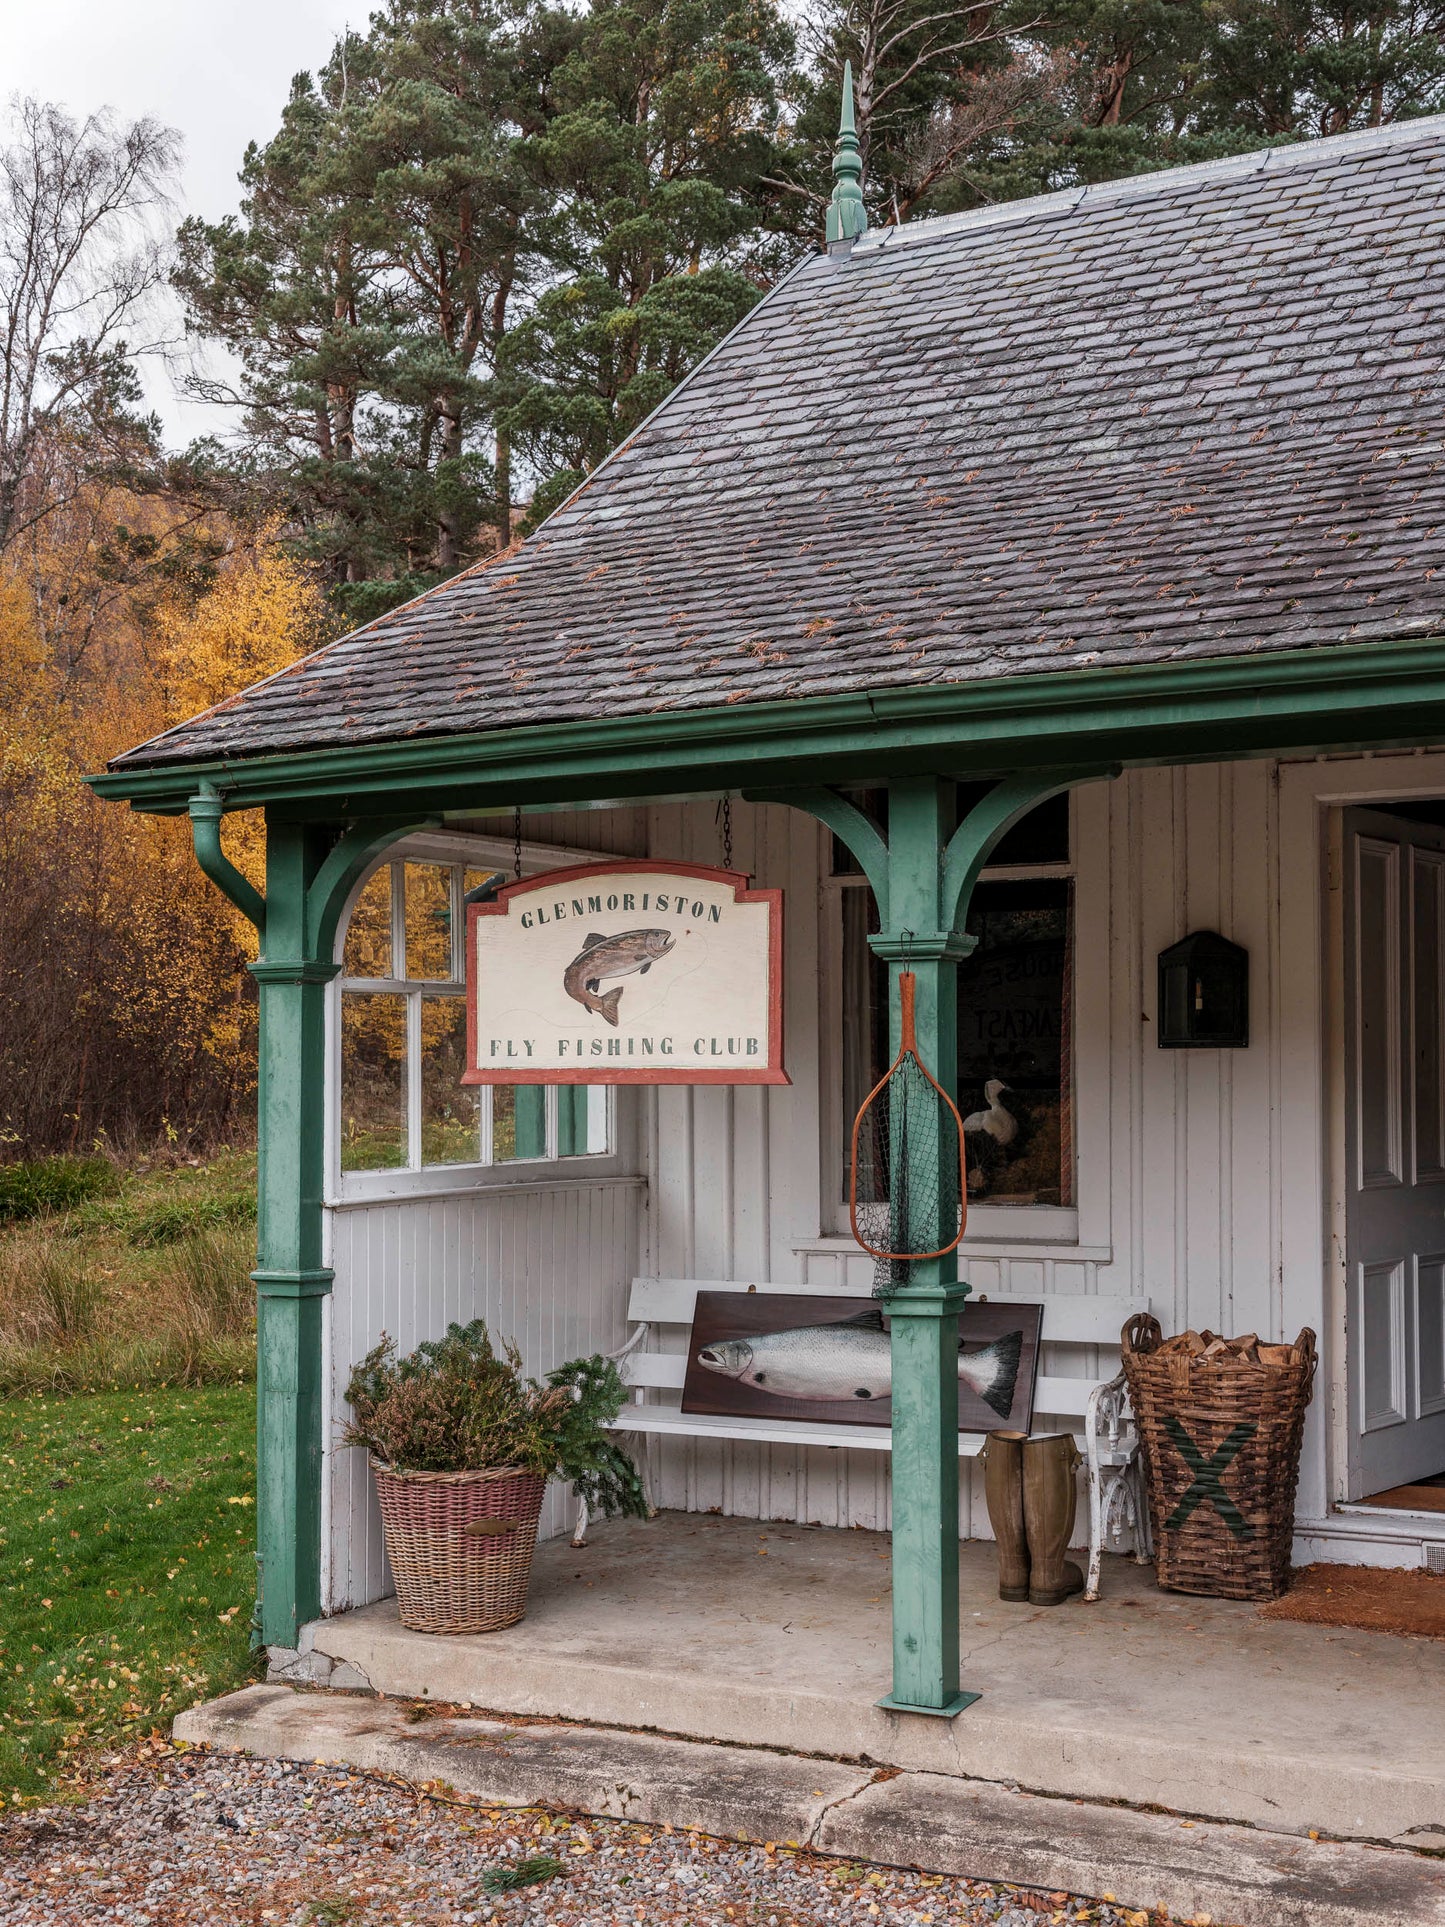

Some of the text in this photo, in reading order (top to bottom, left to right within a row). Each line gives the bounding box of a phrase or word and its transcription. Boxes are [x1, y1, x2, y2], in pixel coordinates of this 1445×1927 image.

[521, 893, 723, 929] GLENMORISTON
[490, 1037, 760, 1057] FLY FISHING CLUB
